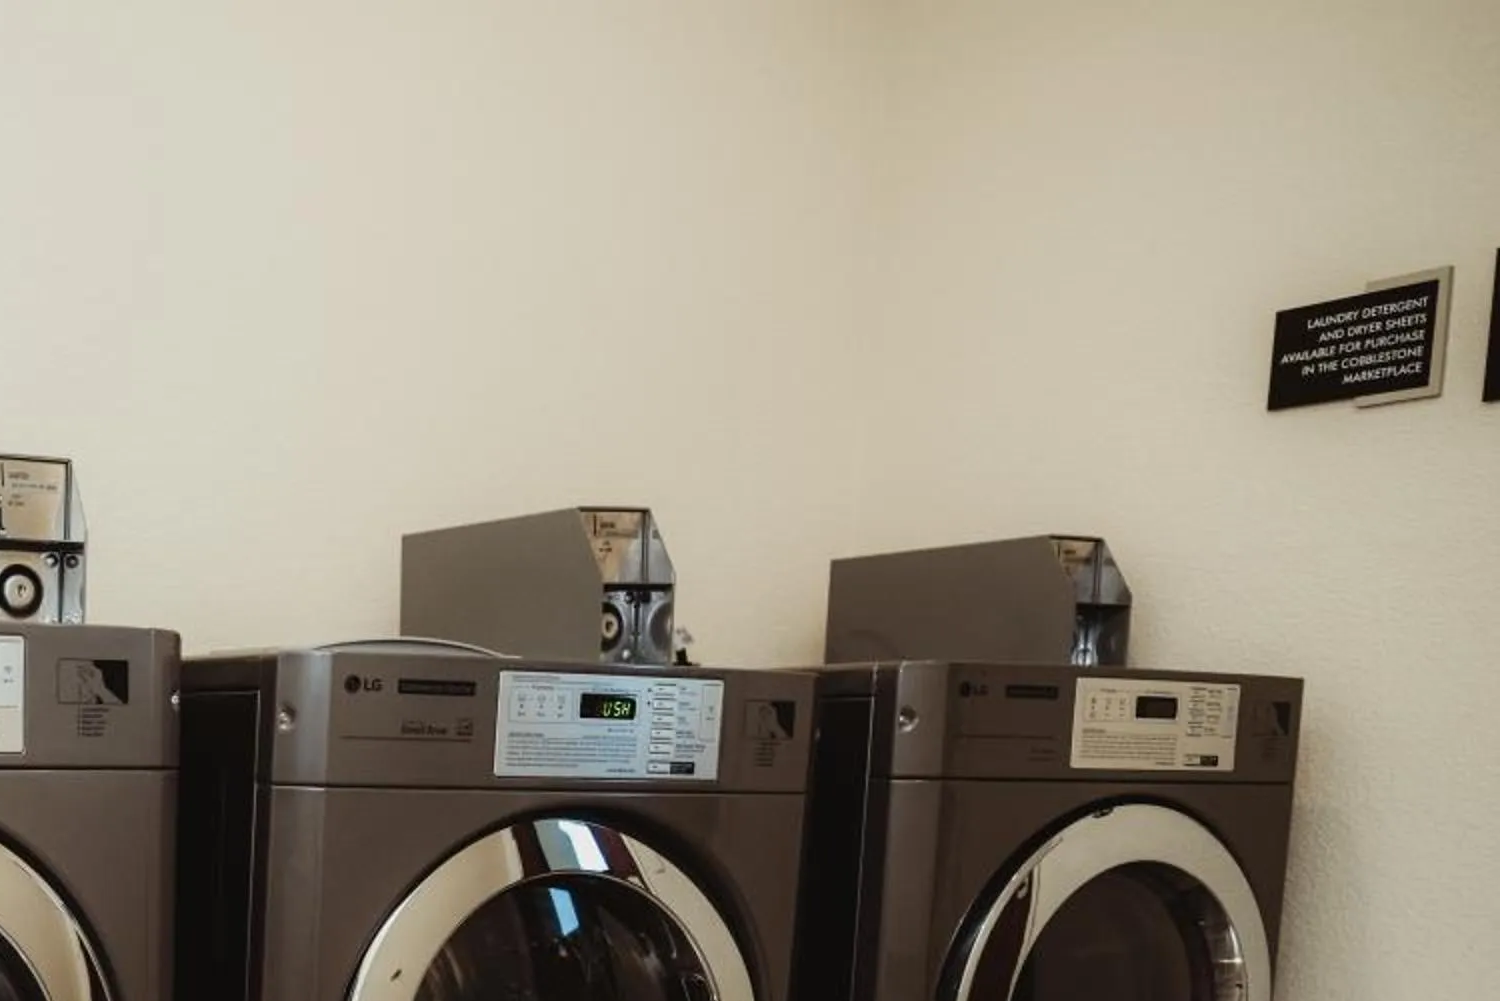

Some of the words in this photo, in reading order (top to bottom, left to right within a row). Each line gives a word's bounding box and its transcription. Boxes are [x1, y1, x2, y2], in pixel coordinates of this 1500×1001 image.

[1307, 309, 1359, 329] LAUNDRY
[1361, 296, 1429, 319] DETERGENT
[1318, 329, 1345, 343] AND
[1347, 321, 1383, 337] DRYER
[1385, 313, 1428, 331] SHEETS
[1280, 345, 1337, 364] AVAILABLE
[1339, 340, 1362, 354] FOR
[1364, 330, 1426, 349] PURCHASE
[1301, 364, 1315, 377] IN
[1317, 359, 1339, 373] THE
[1341, 346, 1425, 369] COBBLESTONE
[1342, 361, 1424, 384] MARKETPLACE
[363, 678, 383, 692] LG
